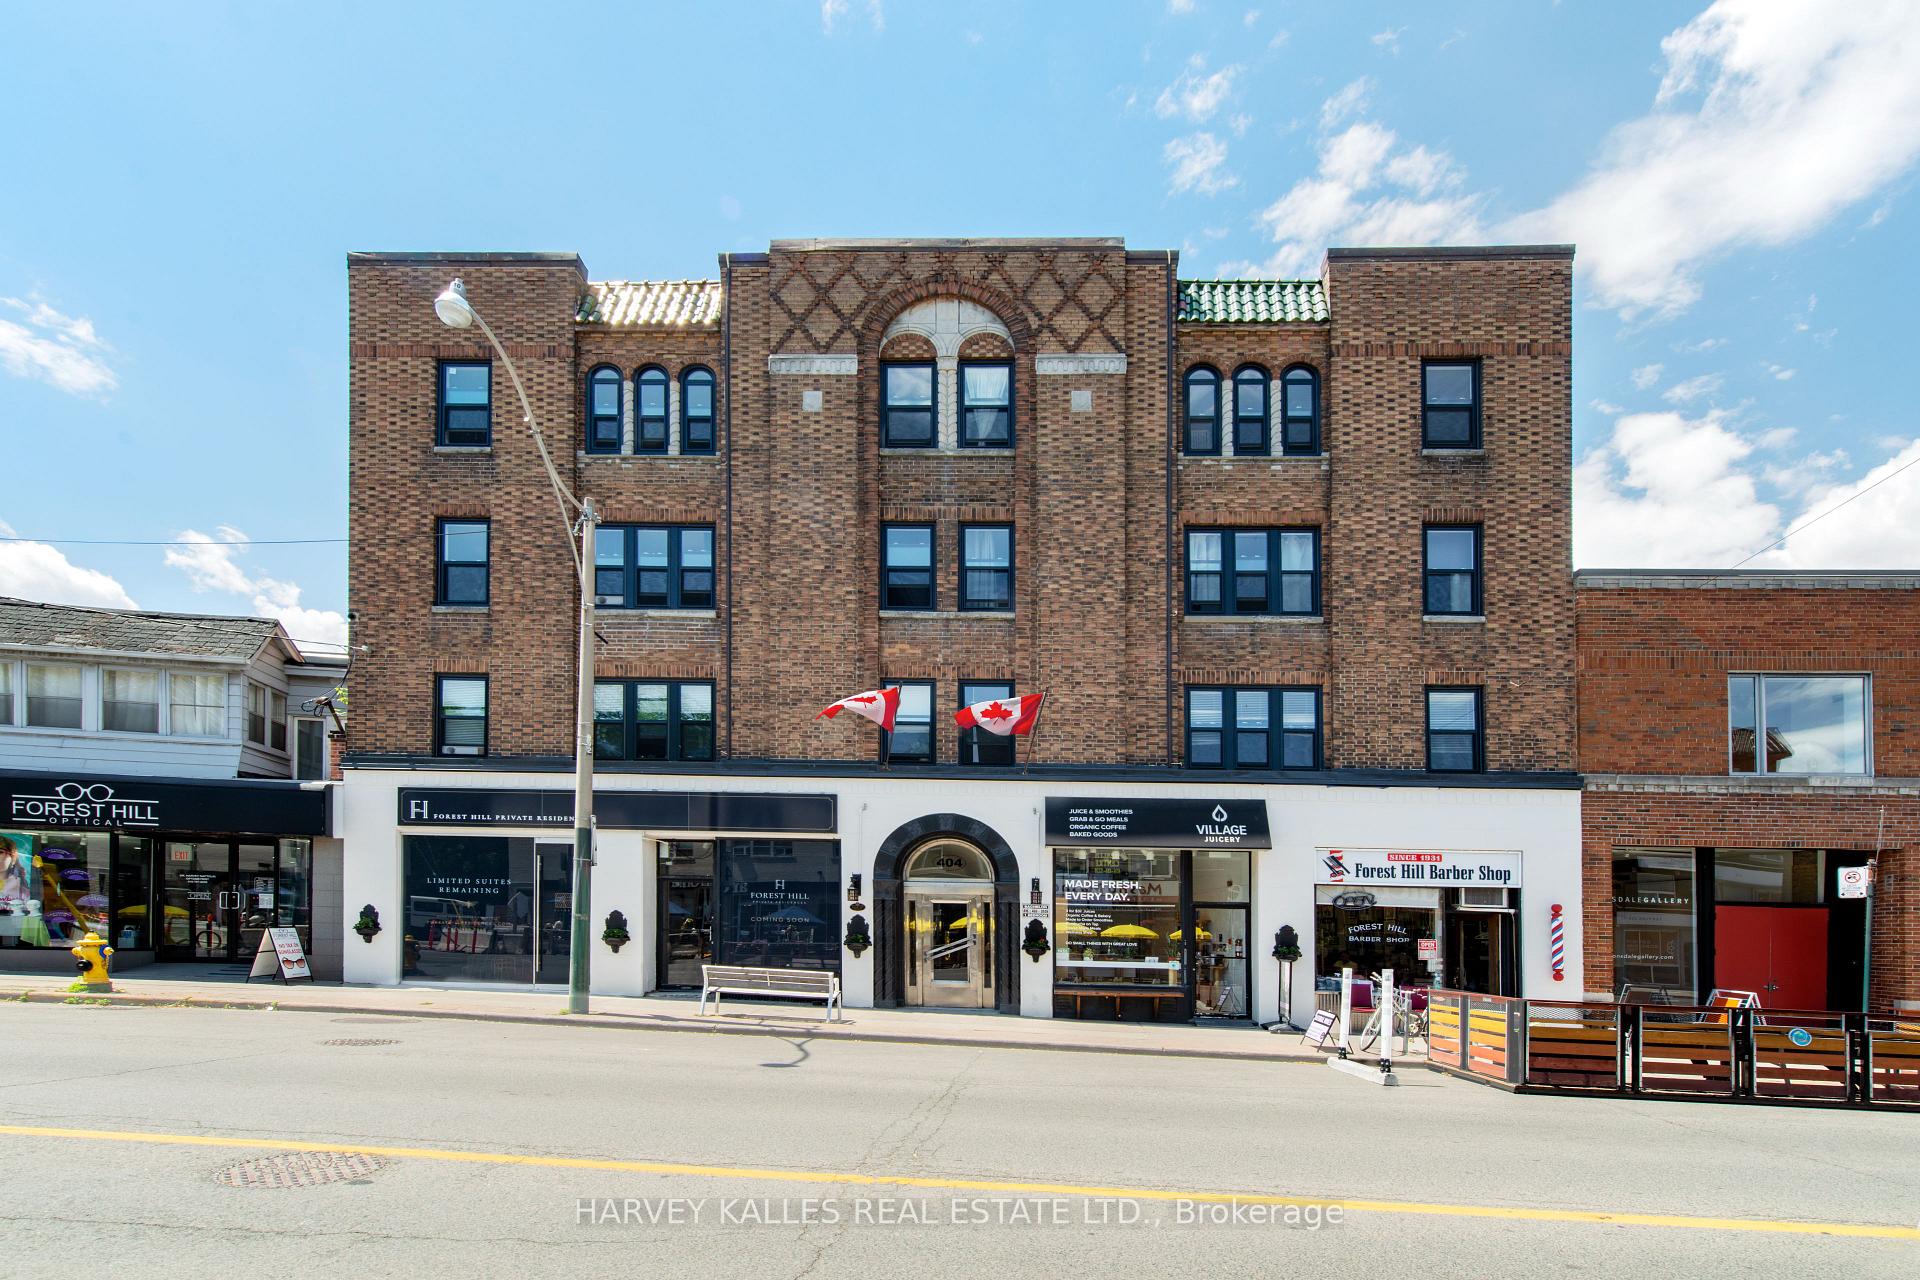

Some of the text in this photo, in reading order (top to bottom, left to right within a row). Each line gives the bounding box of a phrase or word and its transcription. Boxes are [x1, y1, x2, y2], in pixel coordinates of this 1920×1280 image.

[12, 800, 159, 820] FOREST HILL
[50, 817, 123, 827] OPTICAL
[1195, 824, 1248, 836] VILLAGE
[174, 851, 189, 860] EXIT
[937, 858, 963, 867] 404
[1355, 863, 1511, 884] Forest Hill Barber Shop
[1064, 880, 1099, 889] MADE
[1101, 880, 1142, 890] FRESH.
[788, 892, 810, 900] HILL
[1064, 891, 1131, 901] EVERY DAY.
[1348, 923, 1408, 935] FOREST HILL
[1348, 935, 1382, 943] BARBER
